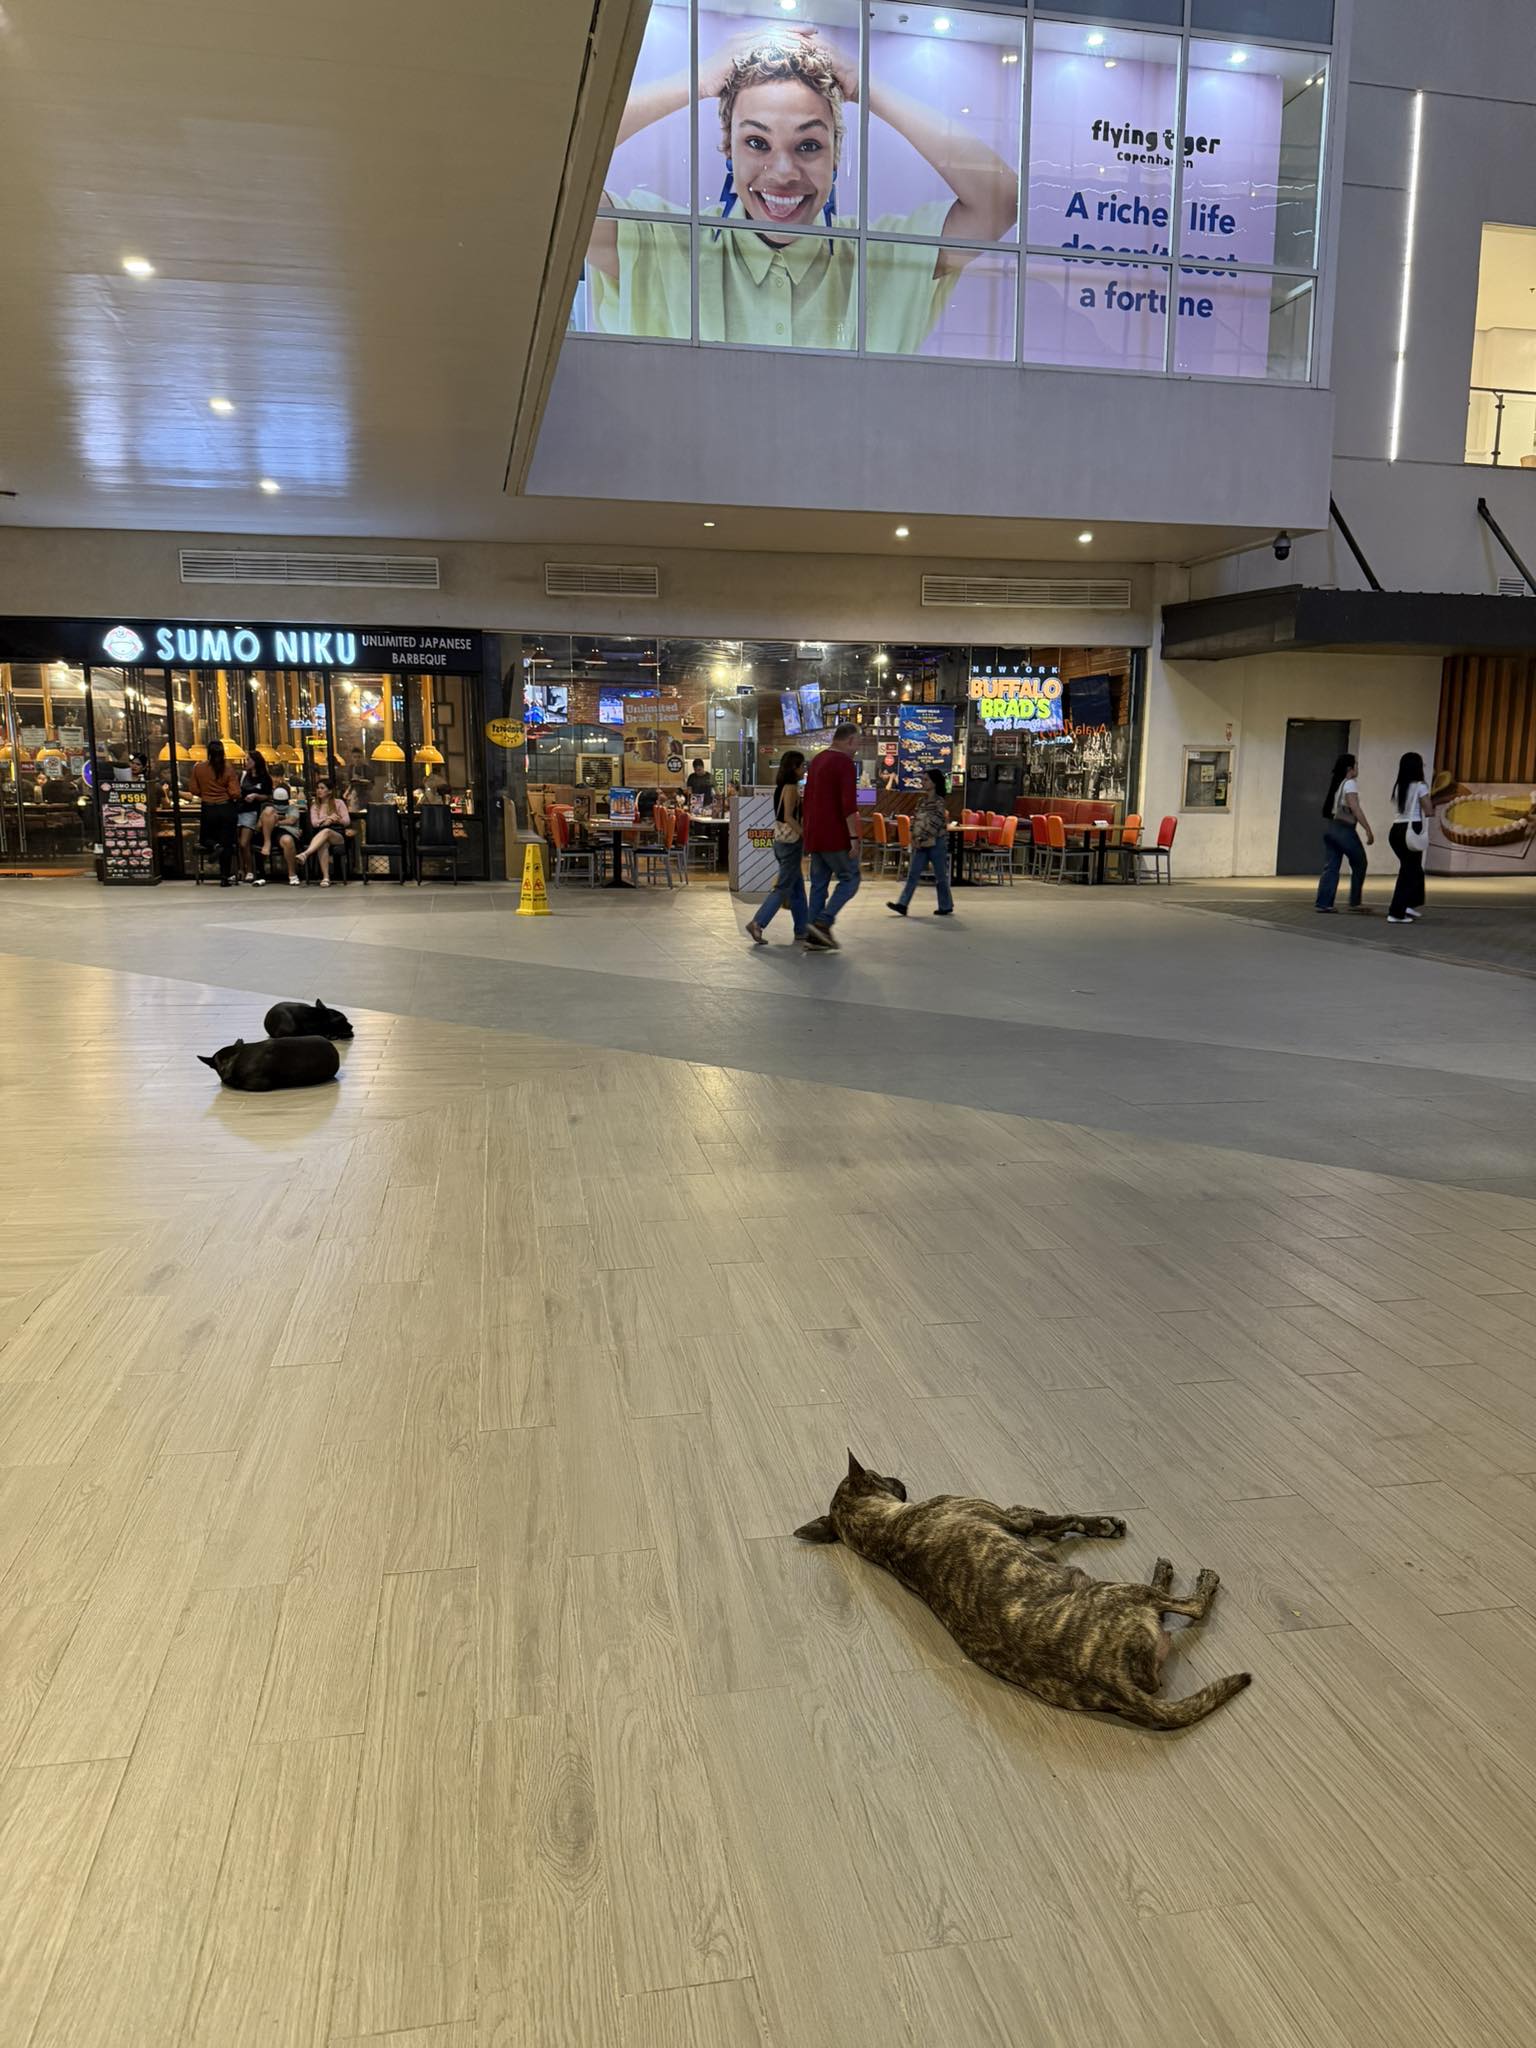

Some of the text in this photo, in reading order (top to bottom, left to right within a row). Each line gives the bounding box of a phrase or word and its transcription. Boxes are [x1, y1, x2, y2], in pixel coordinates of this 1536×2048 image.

[1091, 120, 1221, 156] flying tger
[1117, 152, 1193, 168] copenhan
[1065, 192, 1236, 234] A riche life
[1080, 287, 1096, 308] a
[157, 627, 356, 664] SUMO NIKU
[362, 635, 472, 650] UNLIMITED JAPANESE
[391, 652, 447, 665] BARBEQUE
[973, 665, 1058, 673] NEW YORK
[970, 677, 1063, 699] BUFFALO
[981, 698, 1051, 719] BRAD'S
